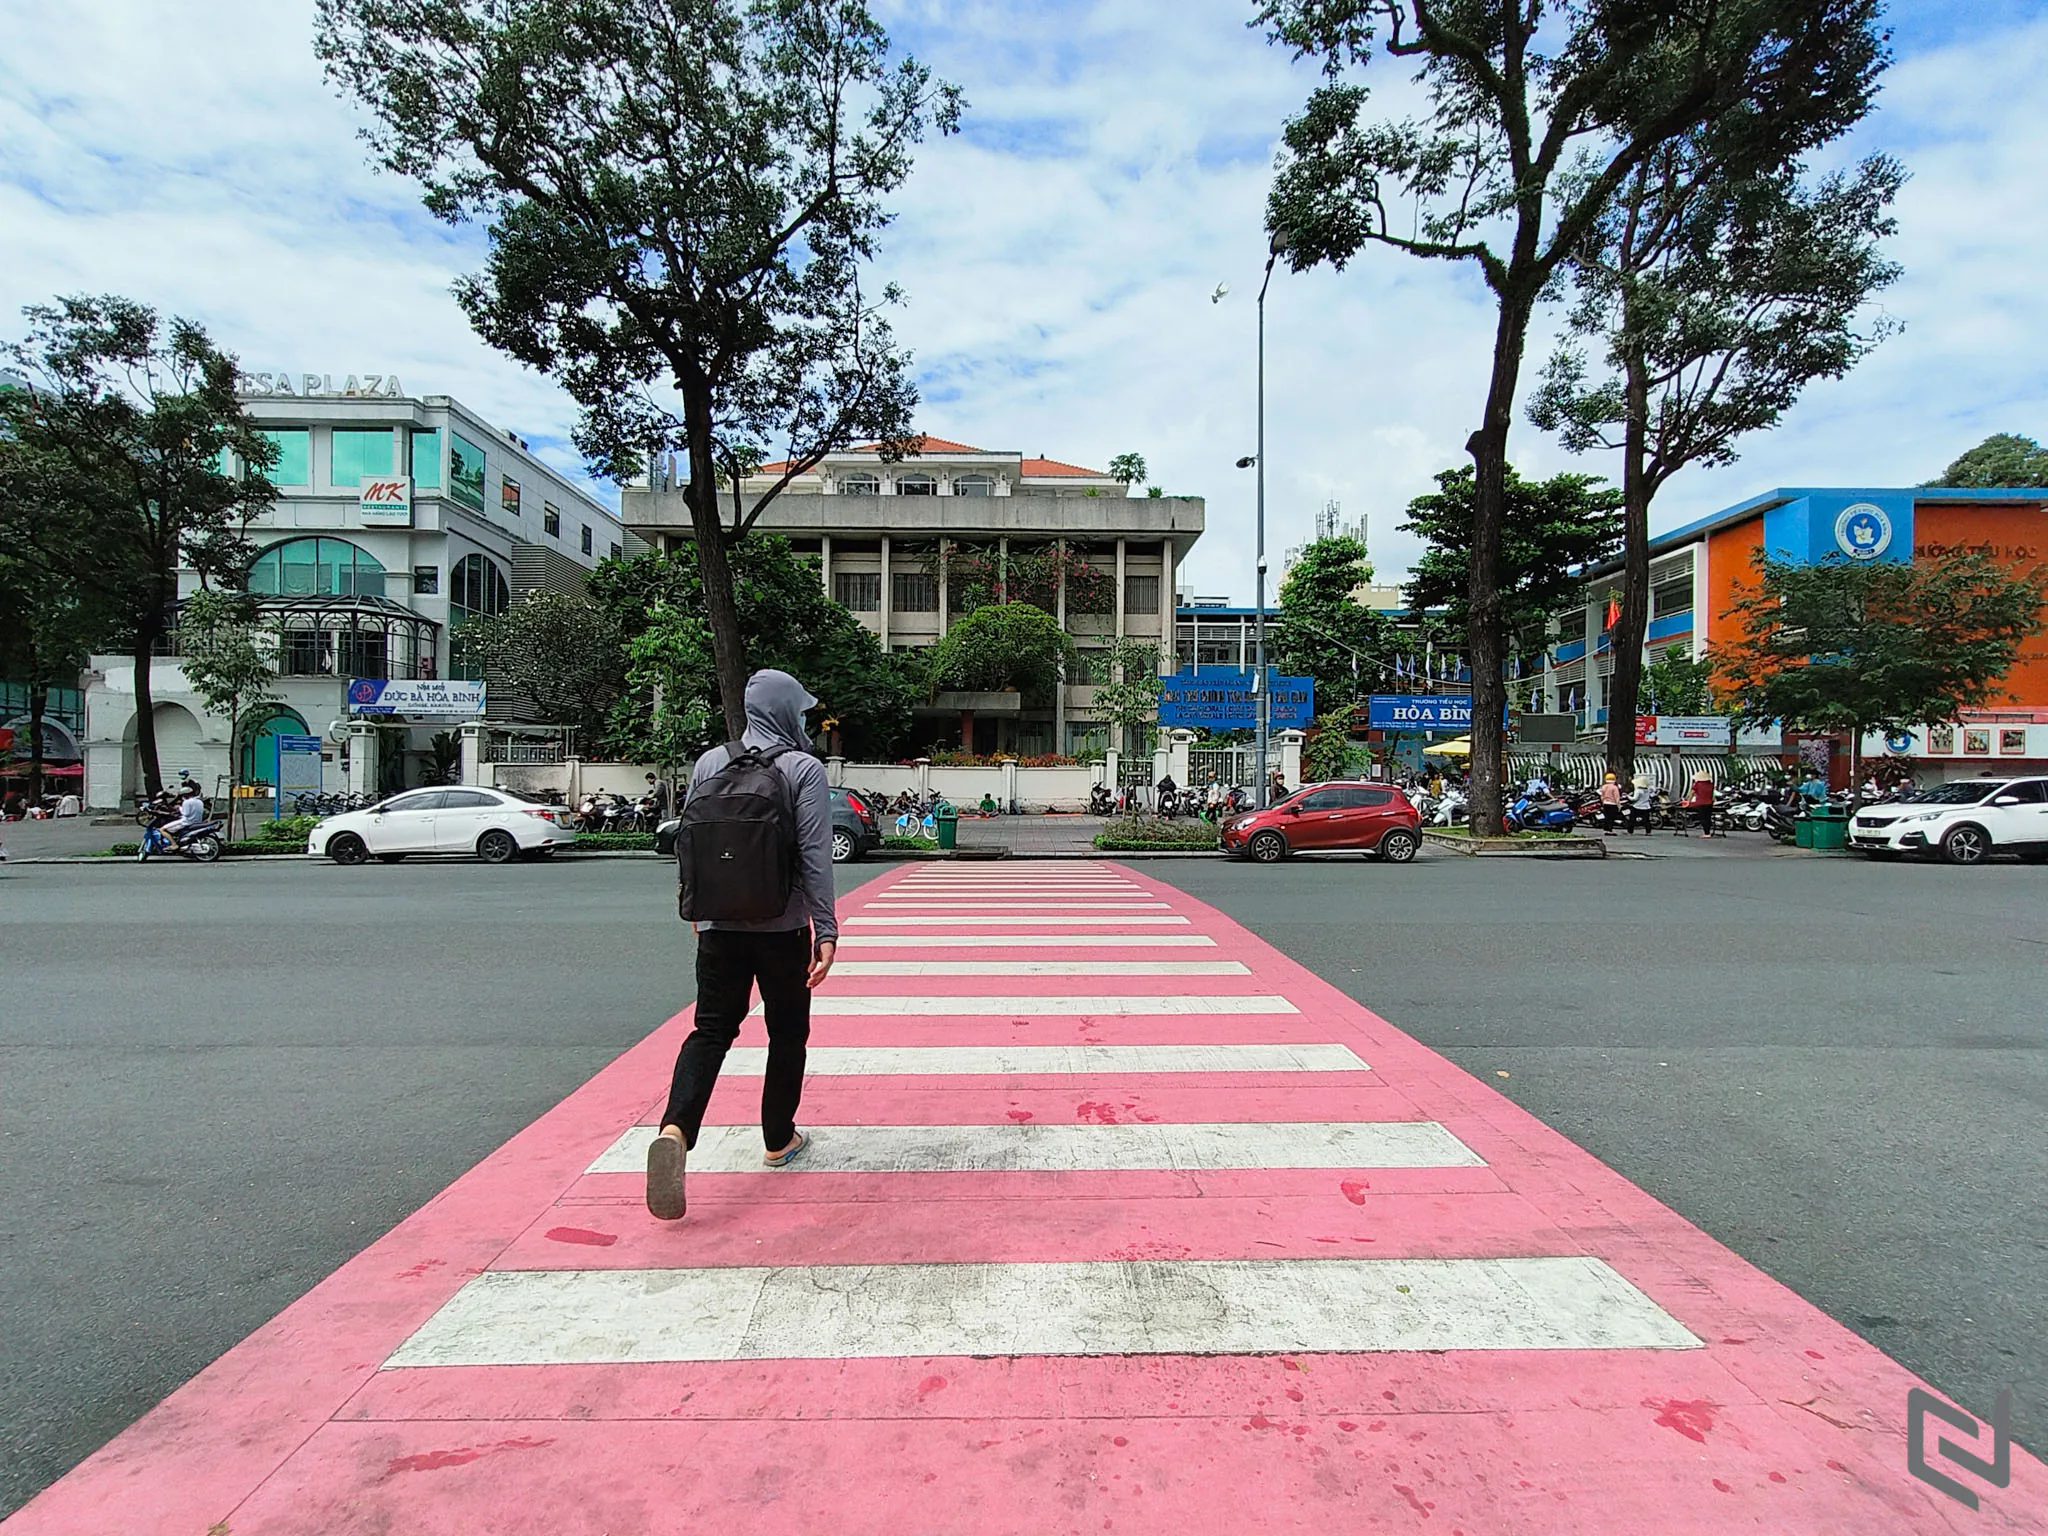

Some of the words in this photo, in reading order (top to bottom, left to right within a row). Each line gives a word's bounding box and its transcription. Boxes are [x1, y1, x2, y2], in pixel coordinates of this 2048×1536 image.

[238, 373, 295, 396] ESA
[302, 374, 404, 398] PLAZA
[364, 482, 406, 501] MK
[452, 692, 480, 702] BÌNH
[1393, 704, 1434, 720] HÒA
[1439, 705, 1472, 720] BÌN
